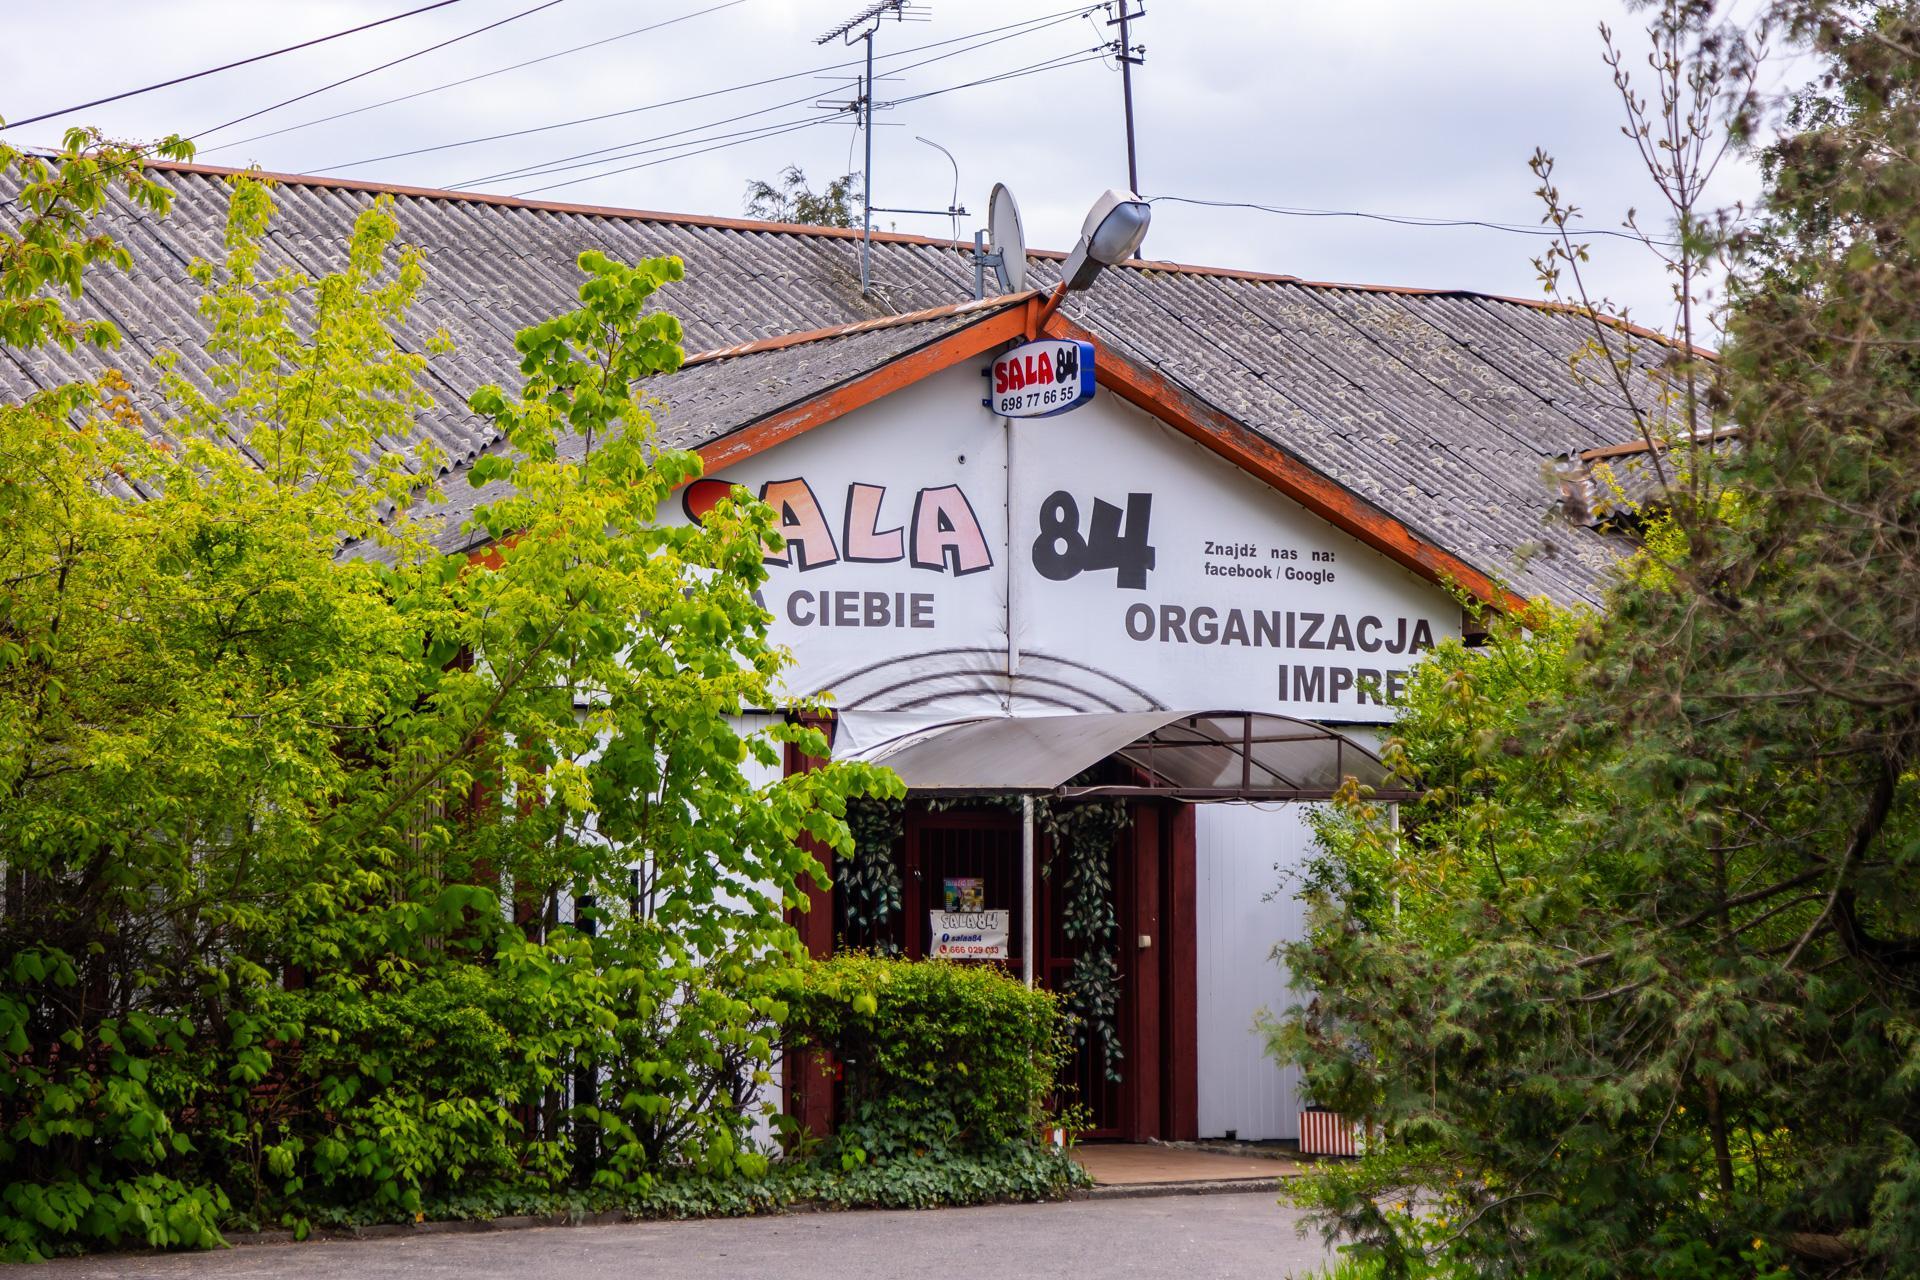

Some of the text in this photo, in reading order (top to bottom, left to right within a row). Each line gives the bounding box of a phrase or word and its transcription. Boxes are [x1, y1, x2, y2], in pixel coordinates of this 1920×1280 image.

[994, 345, 1079, 394] SALA 84
[1001, 386, 1074, 412] 698 77 66 55
[1031, 490, 1155, 590] 84
[1204, 541, 1335, 562] Znajdź nas na:
[1204, 562, 1272, 579] facebook
[1284, 567, 1335, 585] Google
[786, 589, 935, 628] CIEBIE
[1125, 603, 1436, 655] ORGANIZACJA
[1278, 664, 1420, 706] IMPRE
